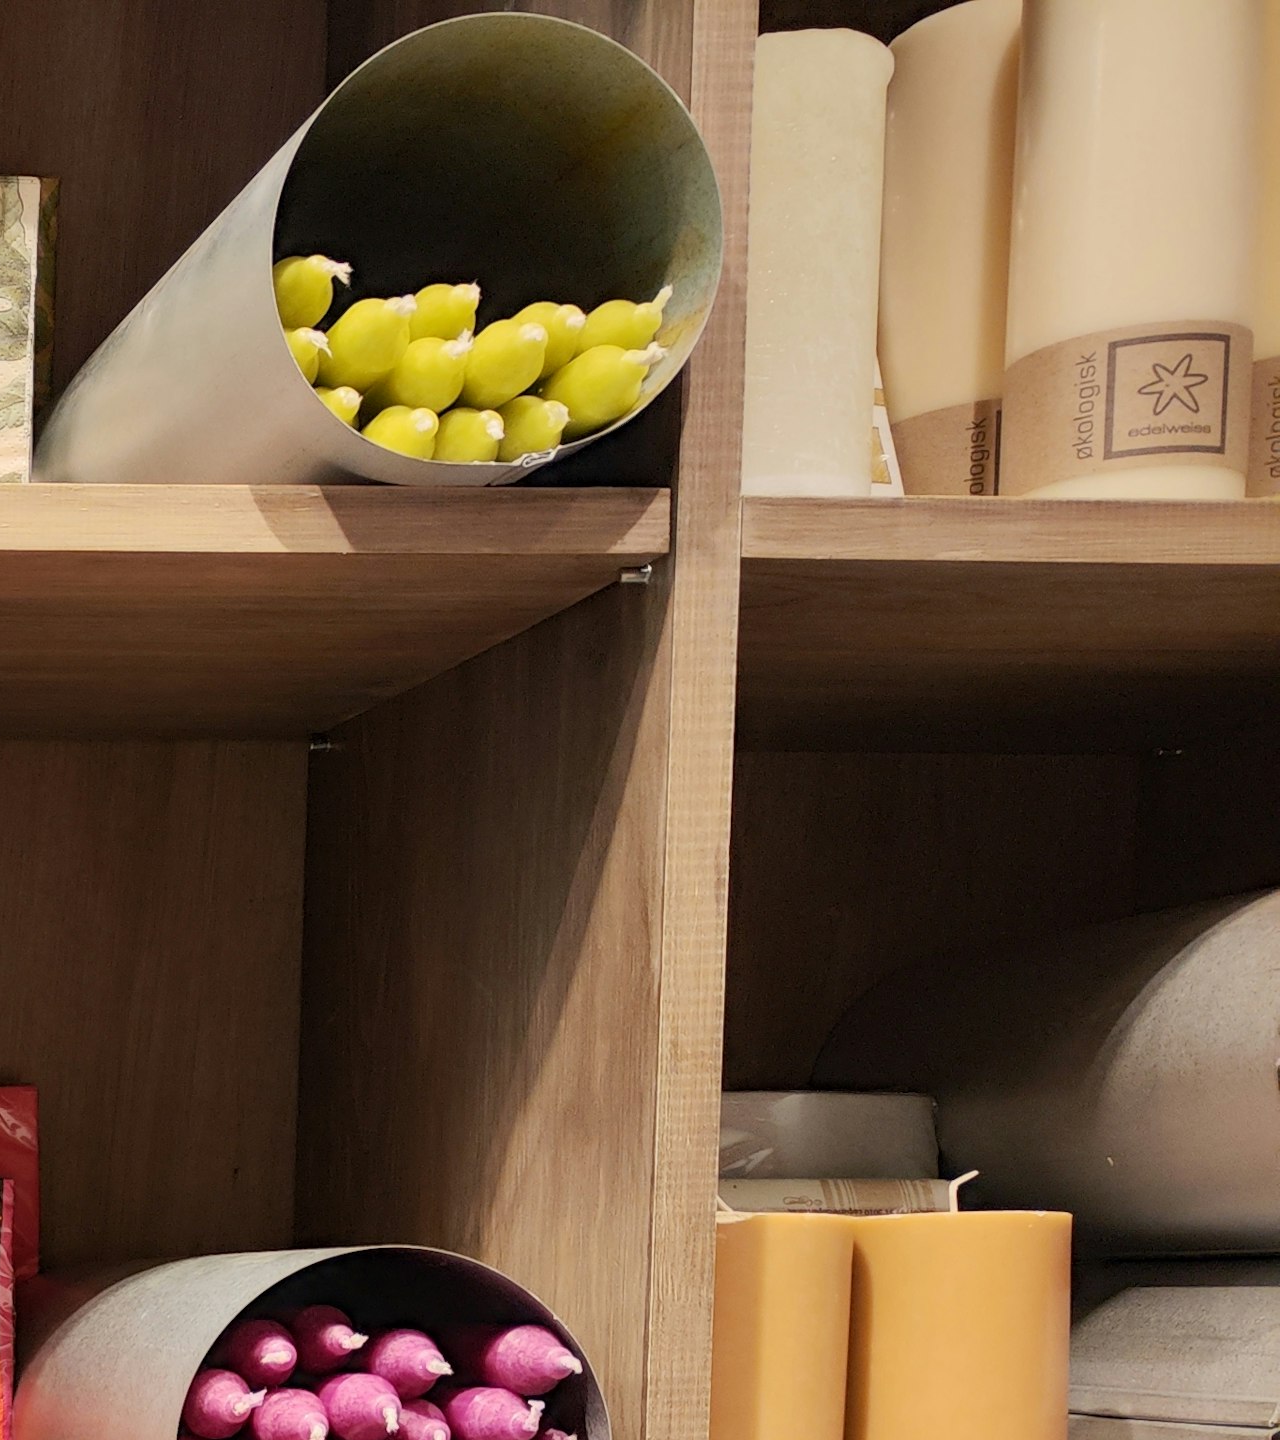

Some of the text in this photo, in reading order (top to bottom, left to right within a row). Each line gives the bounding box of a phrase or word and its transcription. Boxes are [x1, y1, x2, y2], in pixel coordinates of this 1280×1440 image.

[1072, 351, 1100, 460] økologisk
[1128, 421, 1212, 437] edelweiss
[963, 417, 990, 496] ologisk
